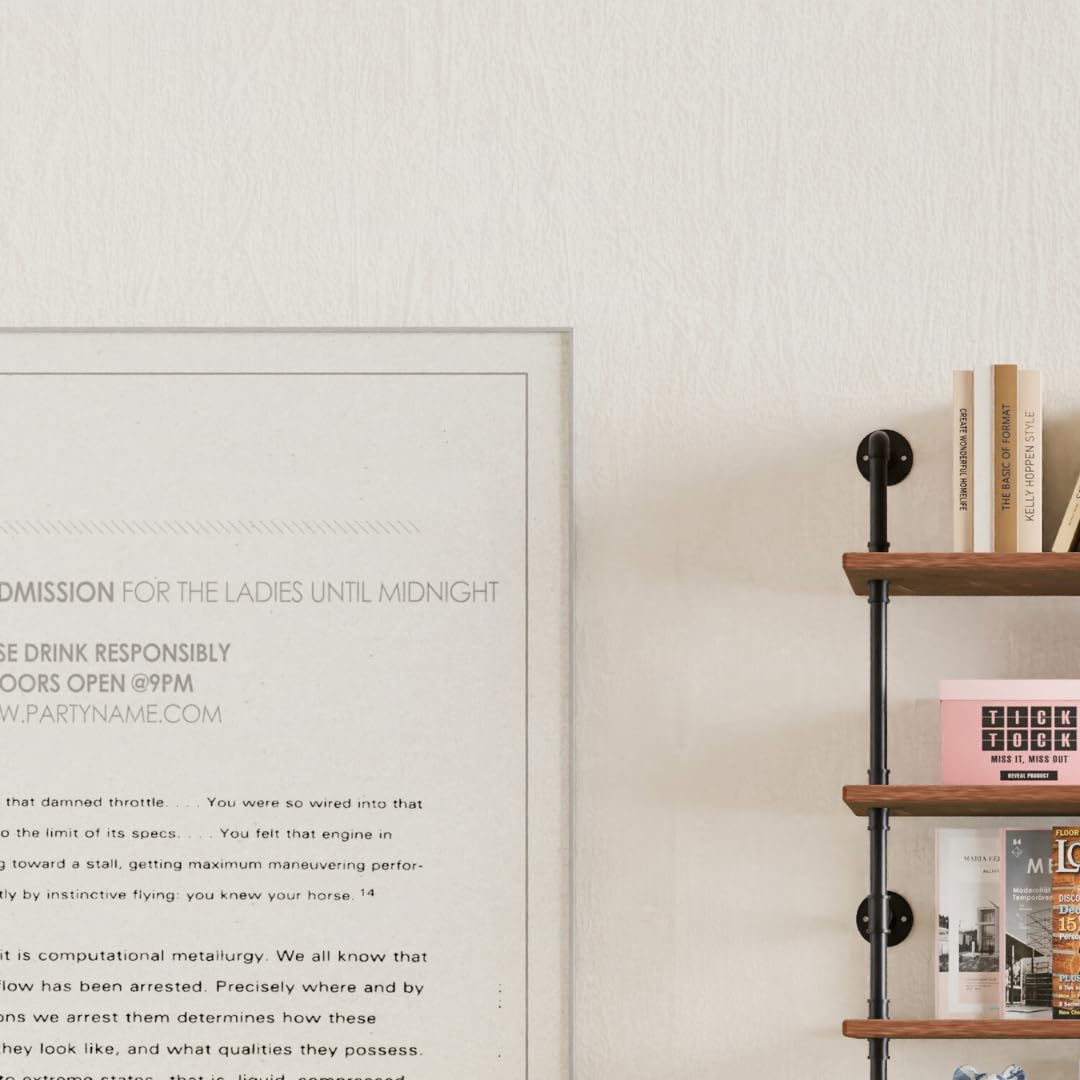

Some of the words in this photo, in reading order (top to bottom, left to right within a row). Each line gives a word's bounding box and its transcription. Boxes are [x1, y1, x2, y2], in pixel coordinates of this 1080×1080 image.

[959, 408, 968, 433] CREATE
[1001, 403, 1011, 443] FORMAT
[1024, 411, 1035, 441] STYLE
[959, 434, 968, 477] WONDERFUL
[1001, 446, 1011, 460] OF
[1024, 445, 1035, 486] HOPPEN
[1001, 463, 1011, 490] BASIC
[959, 478, 968, 511] HOMELIFE
[1001, 493, 1011, 511] THE
[1024, 489, 1035, 522] KELLY
[123, 581, 170, 602] FOR
[178, 581, 217, 602] THE
[225, 581, 303, 602] LADIES
[311, 581, 371, 602] UNTIL
[379, 581, 499, 602] MIDNIGHT
[25, 643, 88, 662] DRINK
[96, 643, 231, 662] RESPONSIBLY
[0, 674, 60, 692] OORS
[67, 674, 125, 692] OPEN
[131, 674, 194, 692] @9PM
[988, 710, 1071, 725] TICK
[988, 733, 1071, 747] TOCK
[991, 755, 1012, 763] MISS
[1015, 755, 1025, 764] IT,
[1028, 755, 1050, 763] MISS
[1053, 755, 1068, 763] OUT
[6, 797, 35, 808] that
[41, 797, 102, 808] damned
[206, 797, 236, 808] You
[242, 799, 280, 808] were
[285, 799, 304, 809] so
[309, 798, 351, 809] wired
[357, 798, 387, 809] into
[393, 798, 423, 809] that
[16, 827, 40, 838] the
[46, 827, 79, 838] limit
[85, 827, 100, 838] of
[107, 827, 125, 838] its
[220, 828, 250, 839] You
[256, 828, 280, 839] felt
[286, 829, 316, 839] that
[322, 829, 373, 842] engine
[379, 830, 393, 840] in
[1055, 829, 1079, 837] FLOOR
[12, 858, 66, 869] toward
[72, 860, 80, 869] a
[86, 858, 122, 870] stall,
[128, 858, 183, 871] getting
[188, 858, 262, 870] maximum
[268, 859, 366, 872] maneuvering
[371, 860, 424, 872] perfor-
[22, 888, 41, 901] by
[47, 888, 127, 900] instinctive
[186, 891, 214, 902] you
[221, 889, 262, 901] knew
[268, 891, 302, 902] your
[360, 887, 375, 897] 14
[1058, 917, 1077, 931] 15
[18, 949, 31, 961] is
[38, 949, 164, 963] computational
[275, 950, 305, 962] We
[311, 950, 331, 962] all
[338, 950, 387, 962] know
[393, 951, 428, 963] that
